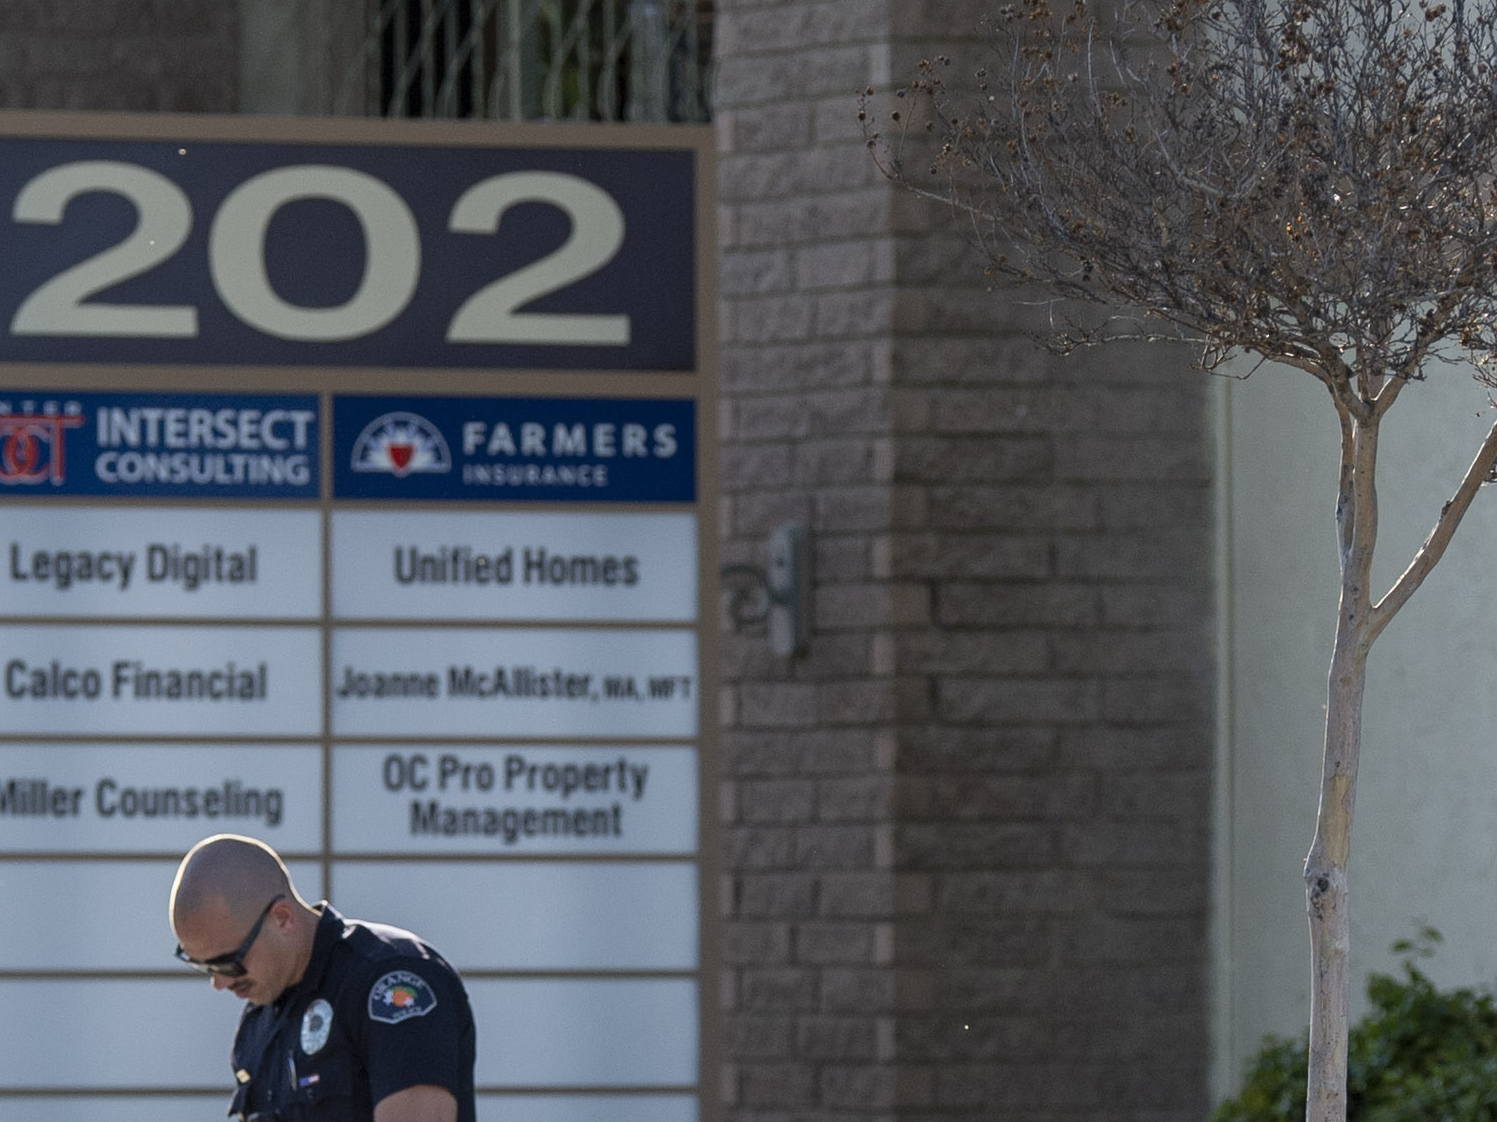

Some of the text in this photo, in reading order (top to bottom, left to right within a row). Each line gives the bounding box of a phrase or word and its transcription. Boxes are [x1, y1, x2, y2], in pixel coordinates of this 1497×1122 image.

[8, 159, 632, 346] 202
[96, 407, 315, 450] INTERSECT
[462, 421, 678, 458] FARMERS
[95, 451, 310, 486] CONSULTING
[462, 464, 608, 486] INSURANCE
[9, 543, 258, 591] Legacy Digital
[394, 546, 639, 586] Unified Homes
[5, 660, 268, 701] Calco Financial
[338, 666, 440, 701] Joanne
[448, 666, 599, 703] McAllister,
[383, 755, 648, 799] OC Pro Property
[96, 780, 283, 826] Counseling
[410, 801, 622, 844] Management
